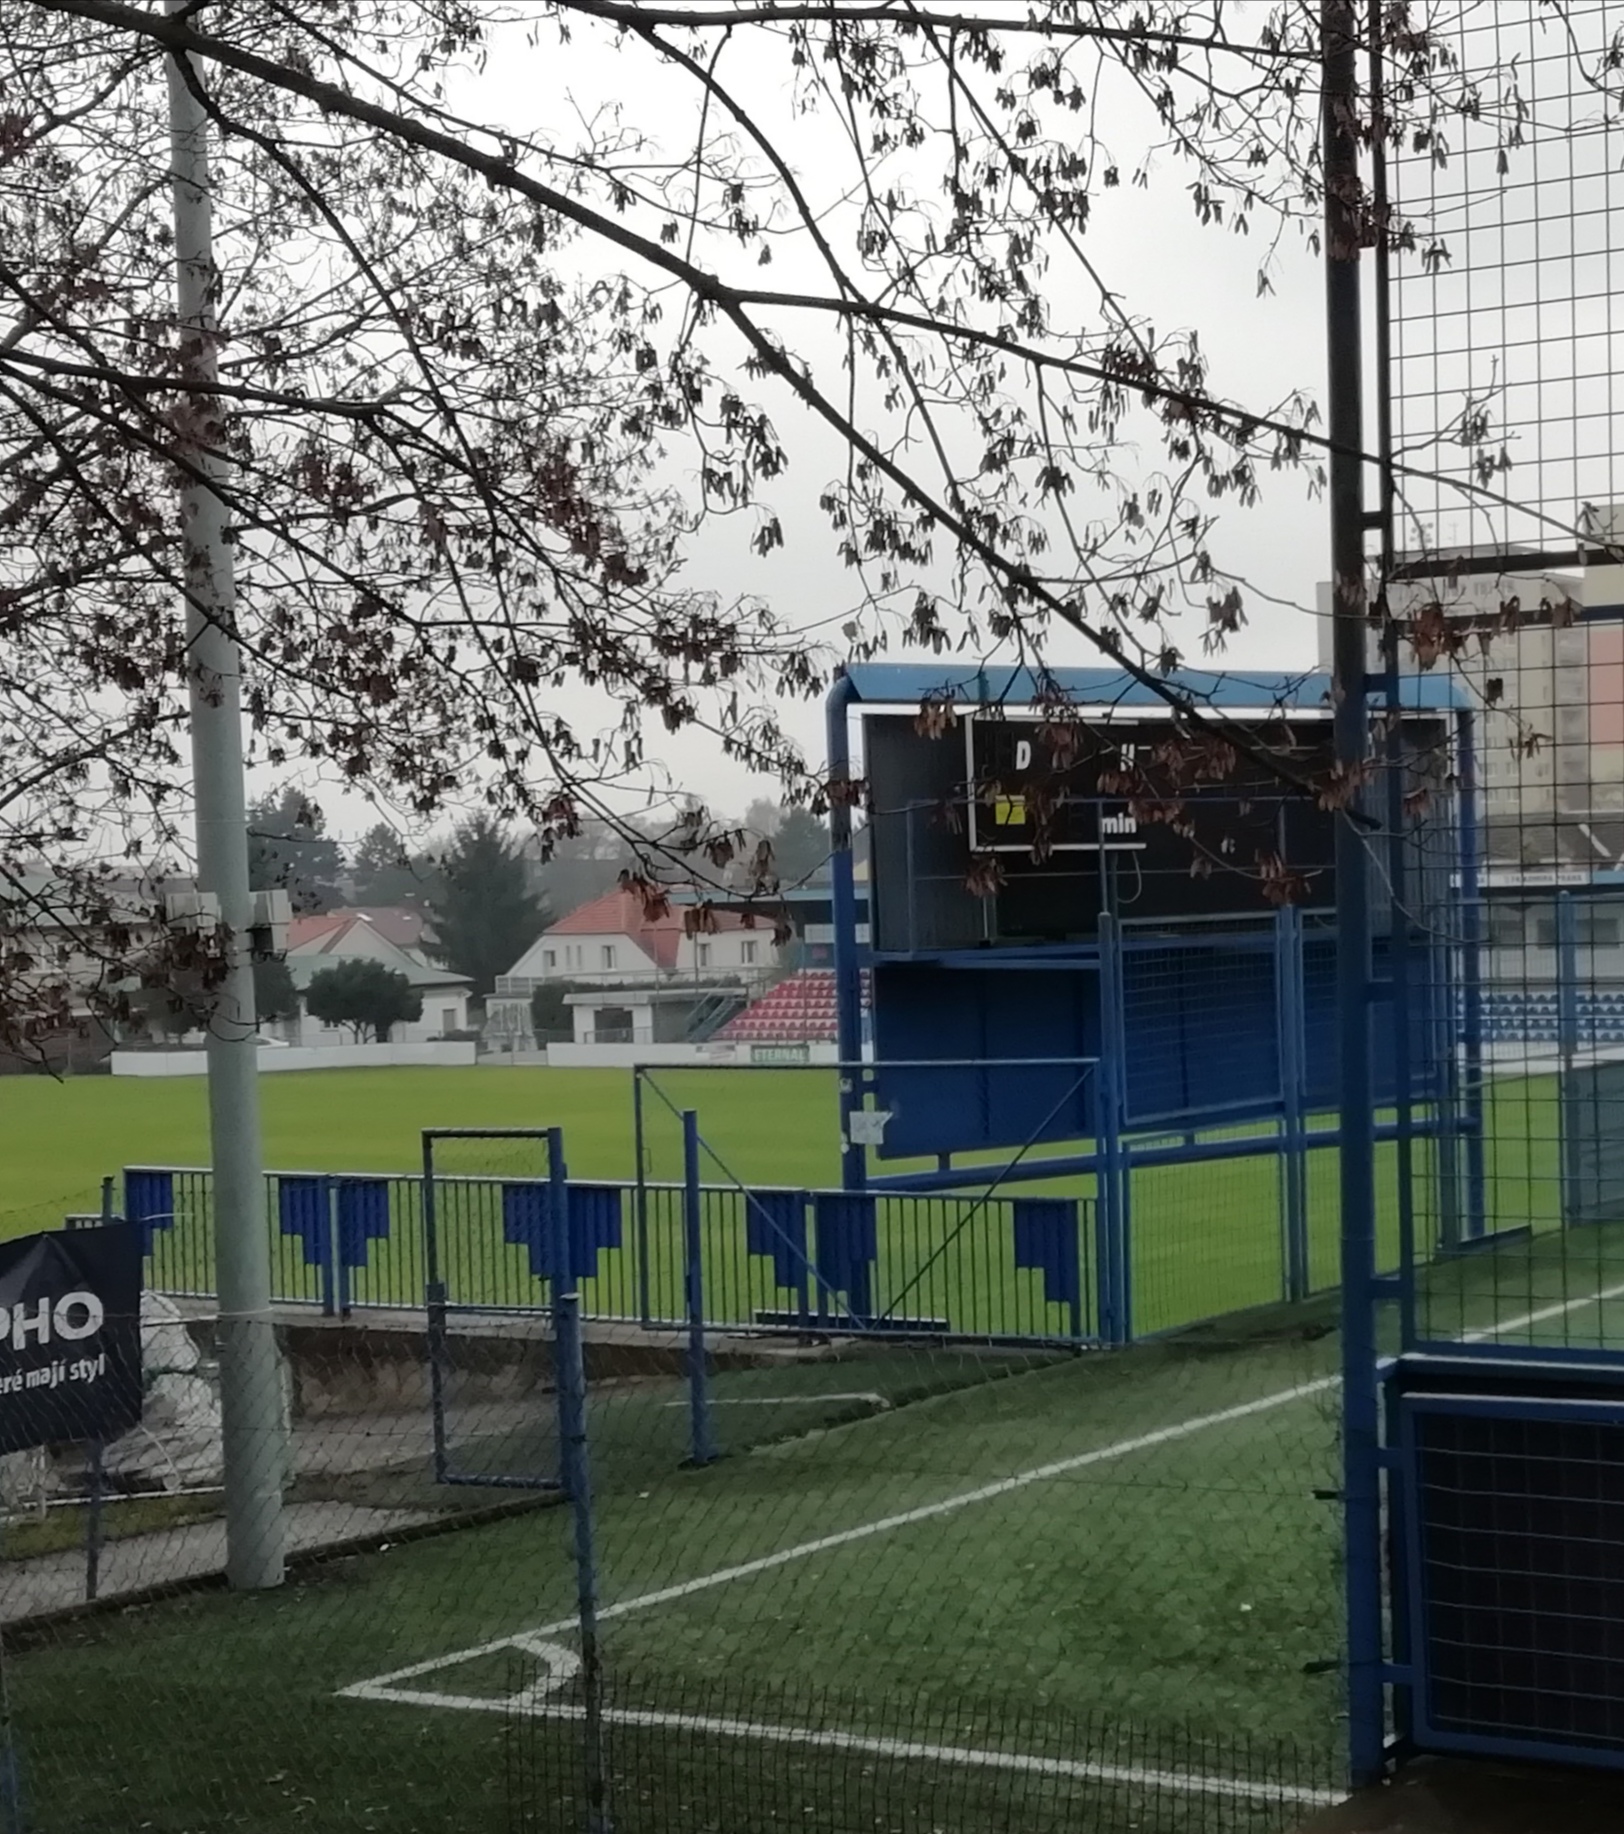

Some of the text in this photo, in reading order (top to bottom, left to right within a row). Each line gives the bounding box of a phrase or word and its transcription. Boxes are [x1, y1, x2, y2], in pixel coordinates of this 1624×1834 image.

[1016, 740, 1031, 770] D
[1101, 812, 1137, 833] min
[26, 1358, 67, 1389] mají
[69, 1352, 105, 1384] styl
